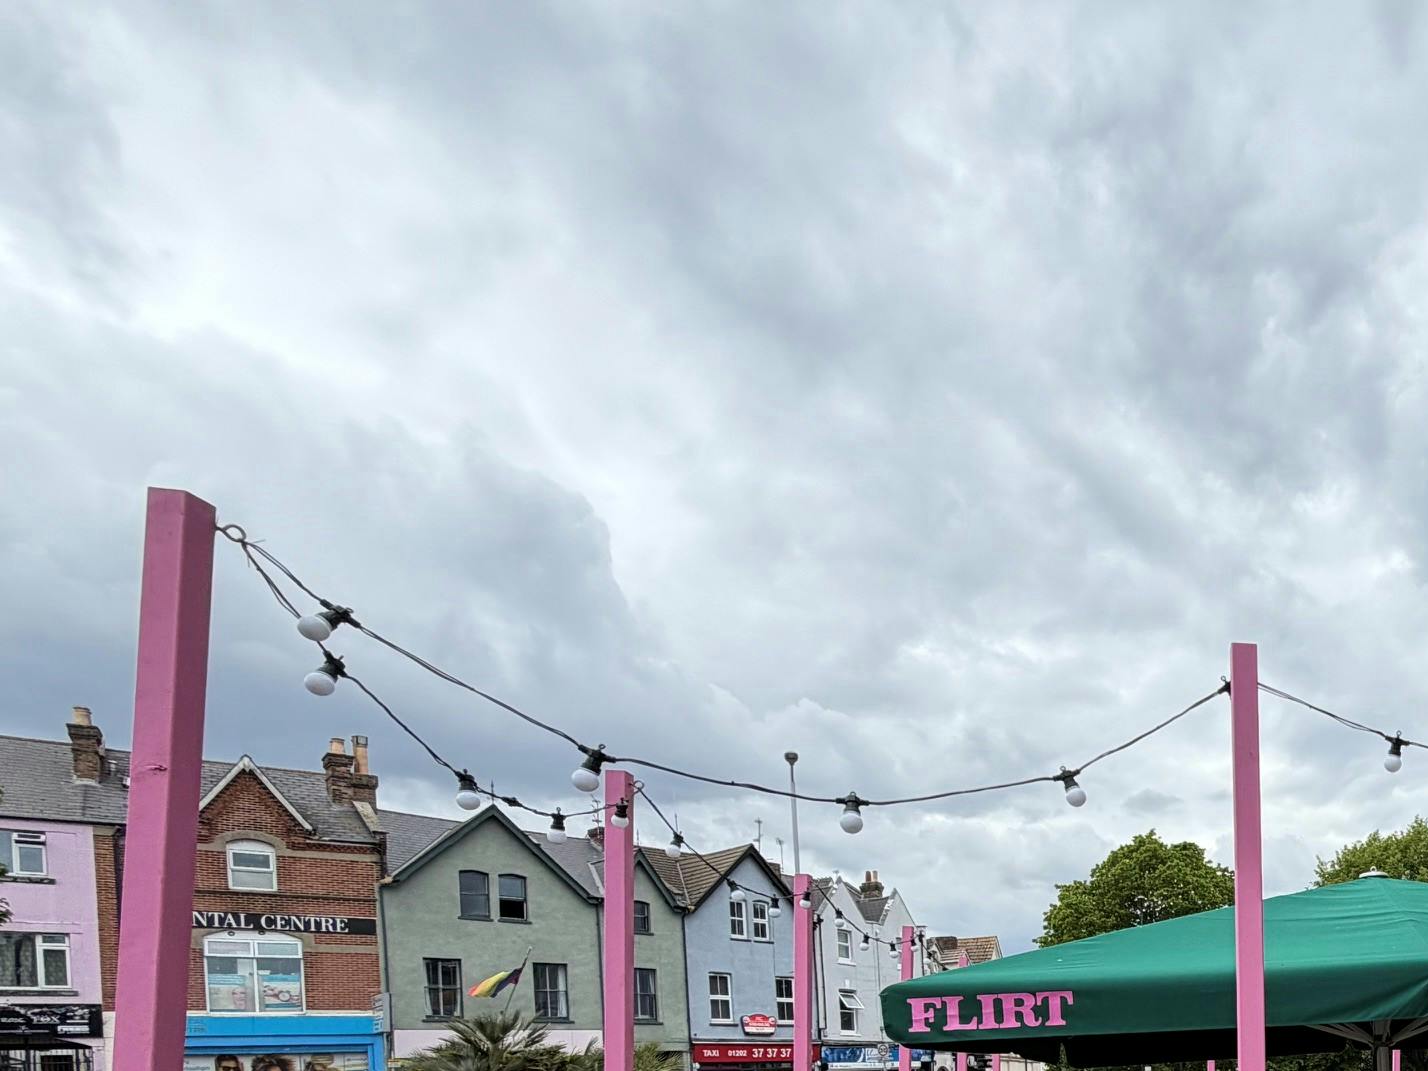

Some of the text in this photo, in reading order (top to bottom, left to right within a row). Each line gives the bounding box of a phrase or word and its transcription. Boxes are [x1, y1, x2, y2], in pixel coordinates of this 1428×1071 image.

[192, 911, 349, 933] NTAL CENTRE
[907, 990, 1074, 1033] FLIRT
[702, 1048, 792, 1058] TAXI 01202 37 37 37
